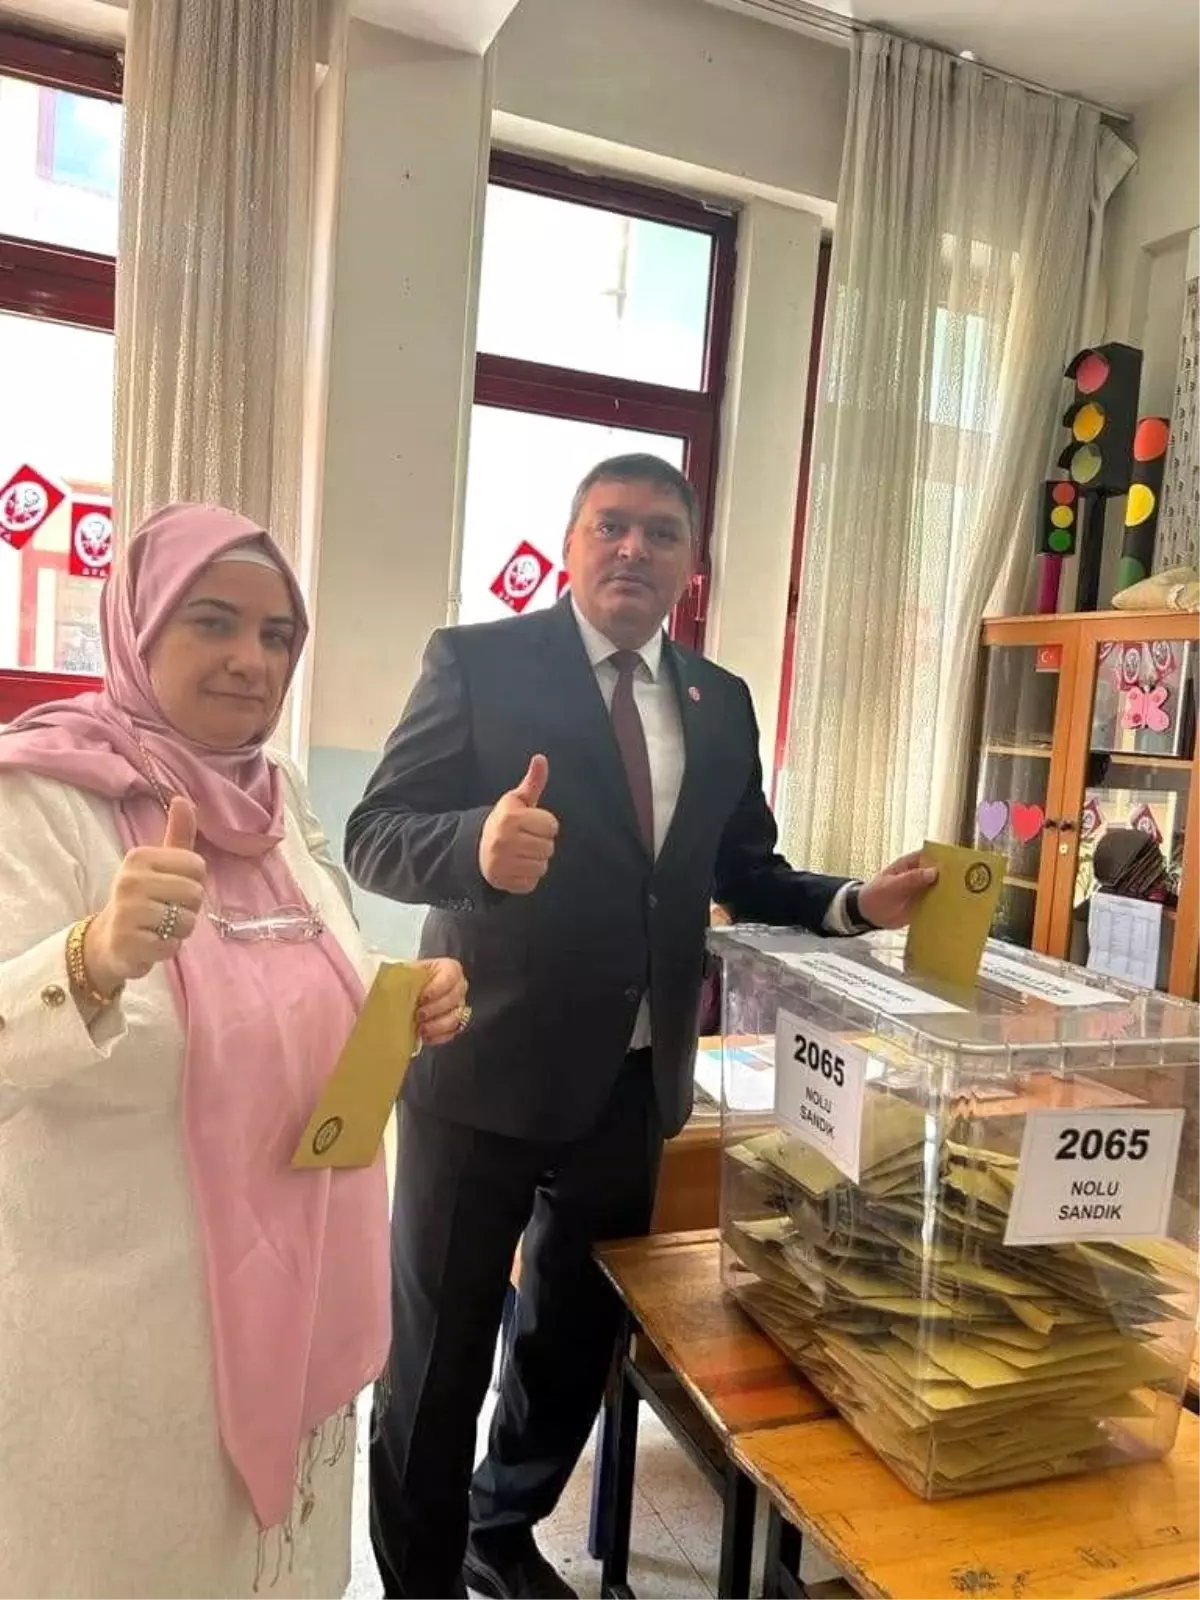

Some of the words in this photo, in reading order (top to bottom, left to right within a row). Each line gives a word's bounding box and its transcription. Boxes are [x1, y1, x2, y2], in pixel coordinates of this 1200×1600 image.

[794, 1034, 845, 1087] 2065
[806, 1086, 832, 1113] NOLU
[800, 1104, 835, 1139] SANDIK
[1055, 1128, 1150, 1160] 2065
[1071, 1180, 1120, 1197] NOLU
[1058, 1204, 1122, 1221] SANDIK
